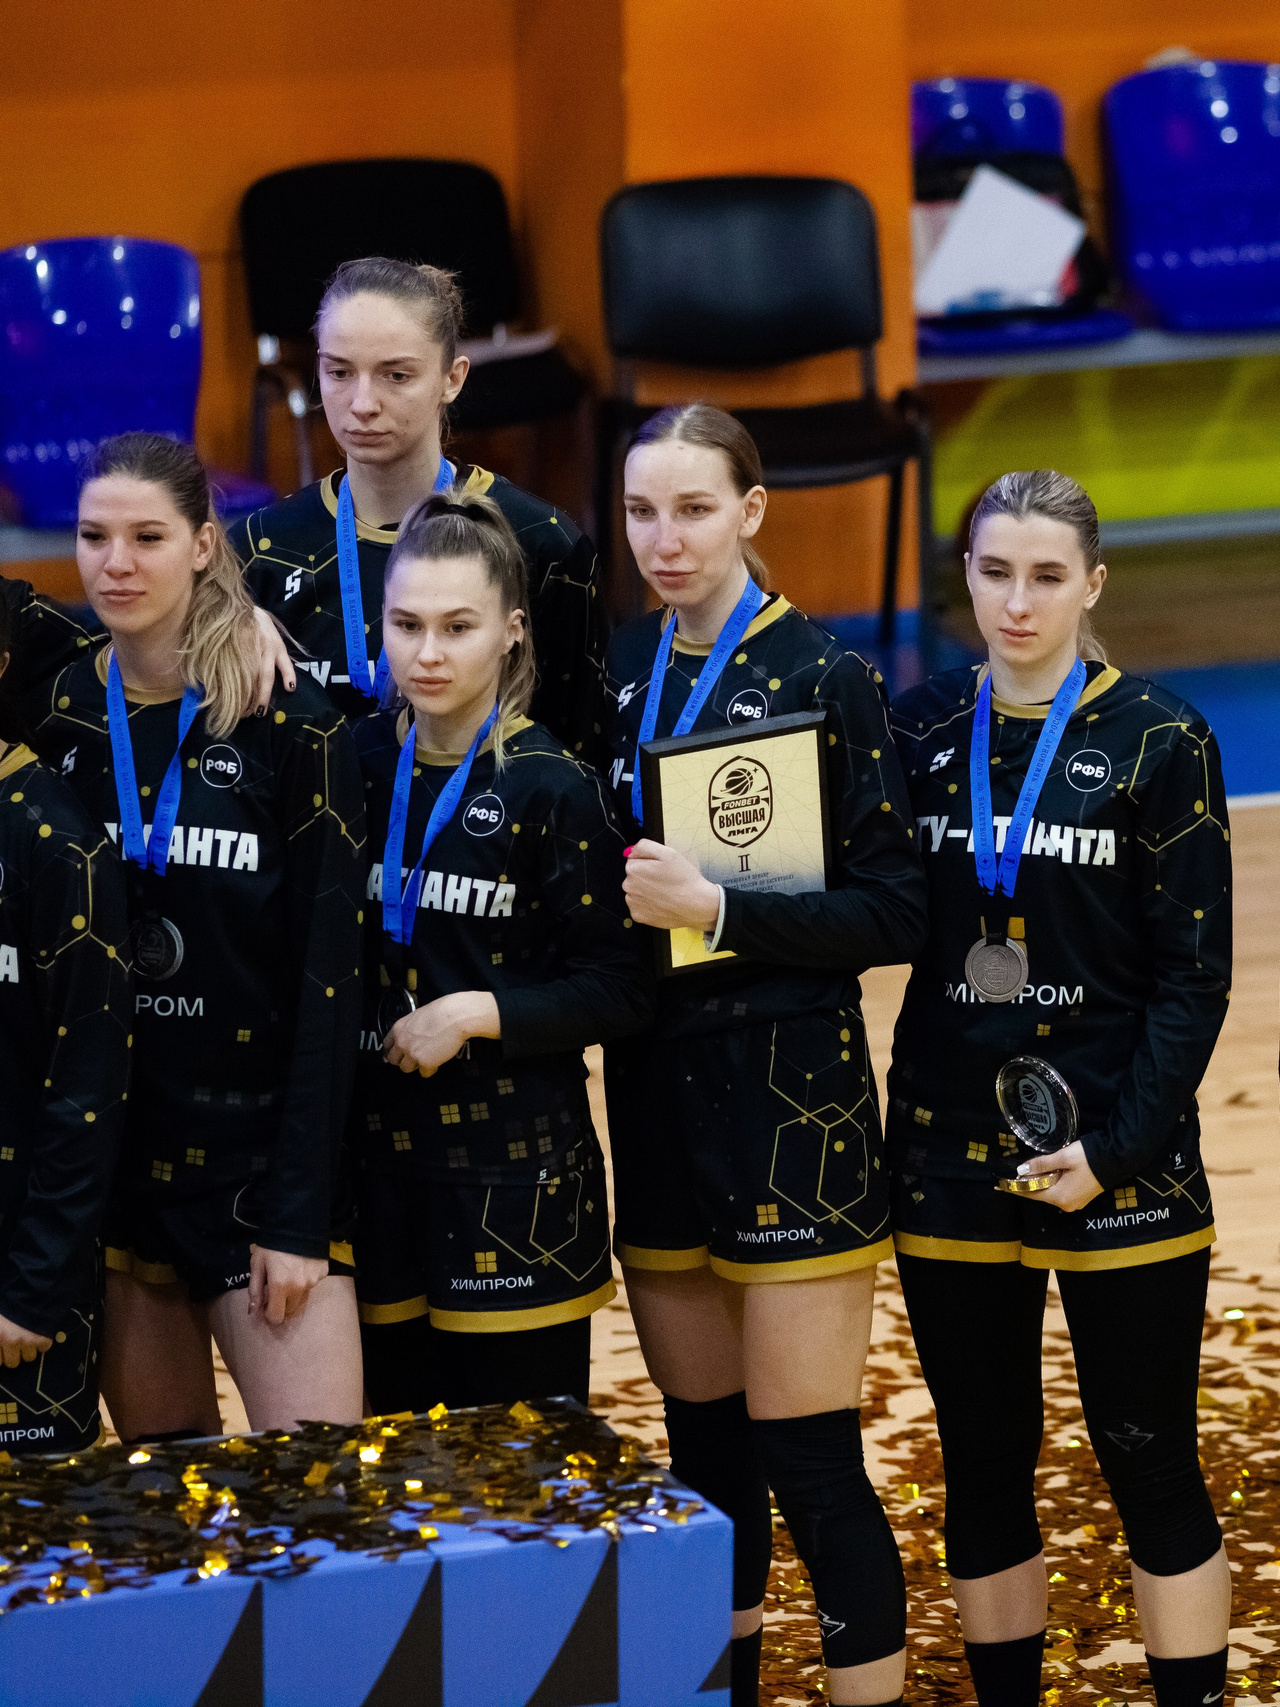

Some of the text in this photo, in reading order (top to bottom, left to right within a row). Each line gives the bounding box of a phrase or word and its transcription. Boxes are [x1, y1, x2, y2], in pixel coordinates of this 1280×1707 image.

[732, 703, 762, 719] РФБ
[206, 758, 238, 774] РФБ
[1071, 762, 1106, 778] РФБ
[724, 797, 758, 810] FONBET
[468, 806, 500, 822] РФБ
[718, 808, 765, 828] ВЫСШАЯ
[728, 826, 758, 837] ЛИГА
[738, 854, 750, 872] II
[1086, 1208, 1170, 1230] ХИМПРОМ
[736, 1228, 814, 1244] ХИМПРОМ
[450, 1275, 533, 1290] ХИМПРОМ
[0, 1426, 54, 1442] ПРОМ
